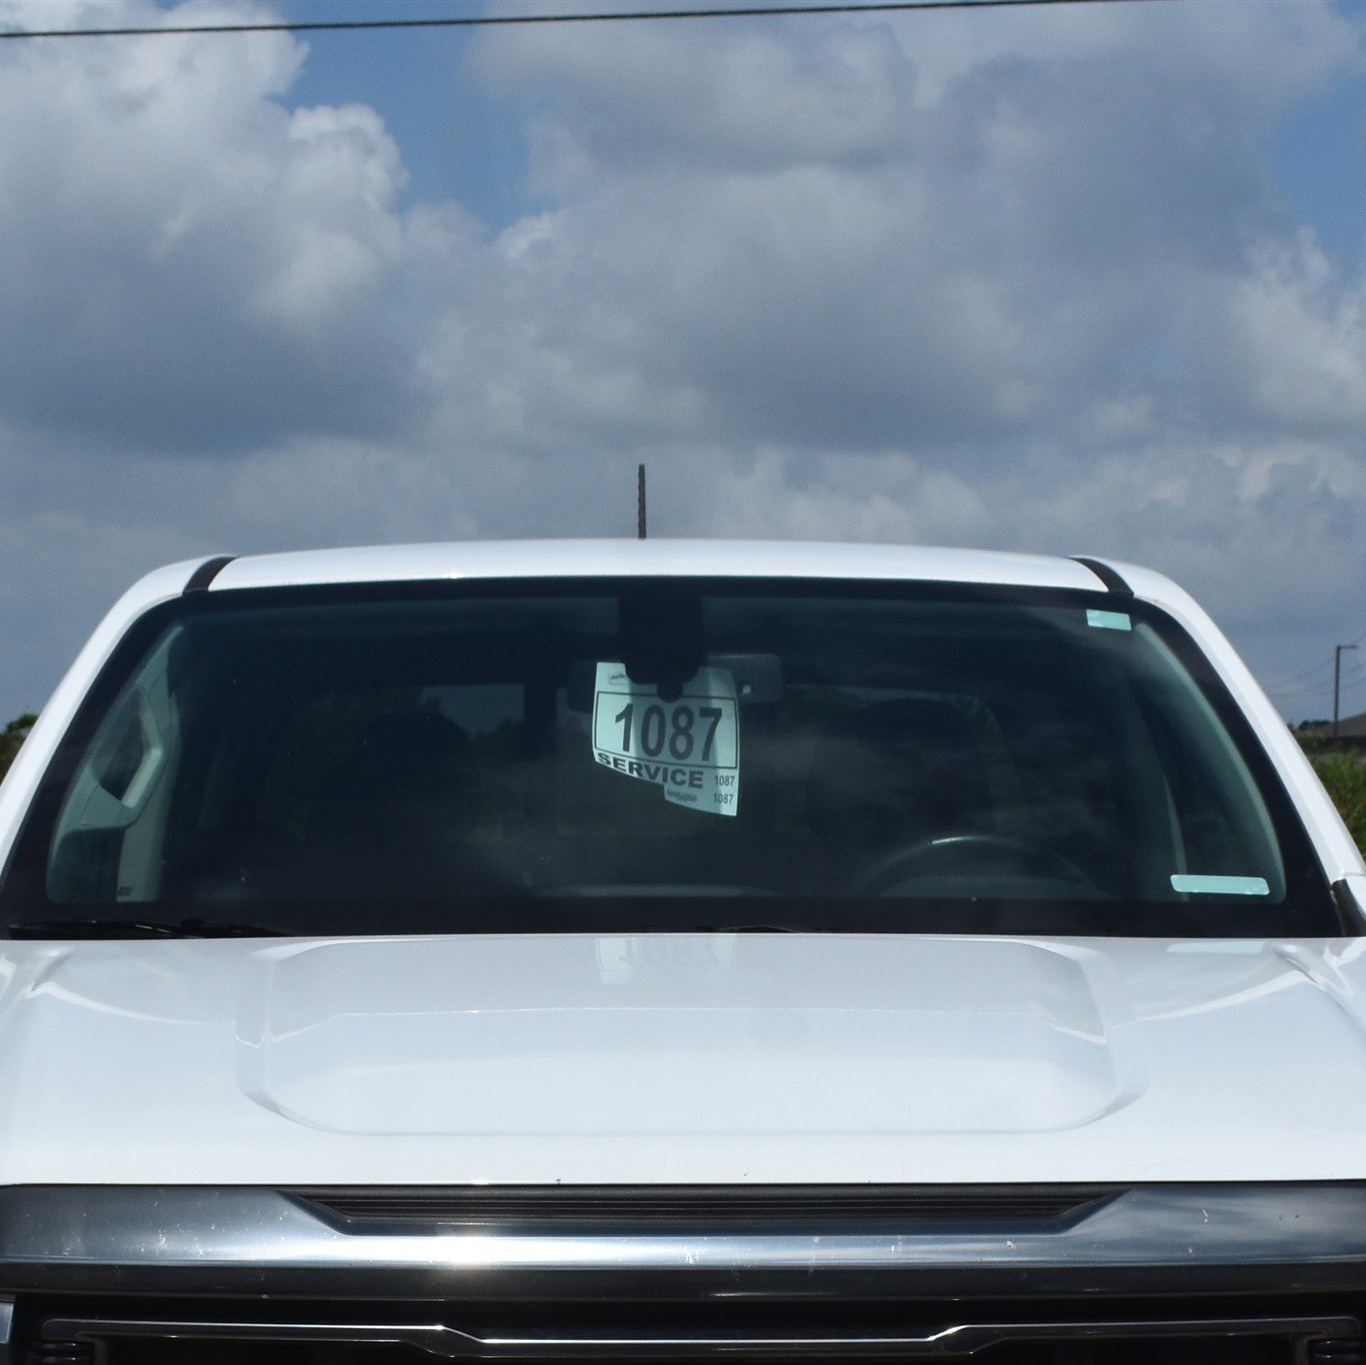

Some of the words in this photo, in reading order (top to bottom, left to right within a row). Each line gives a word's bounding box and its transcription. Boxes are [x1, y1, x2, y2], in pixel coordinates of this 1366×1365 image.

[614, 702, 723, 763] 1087
[597, 752, 704, 789] SERVICE
[714, 774, 735, 787] 1087
[713, 792, 734, 805] 1087
